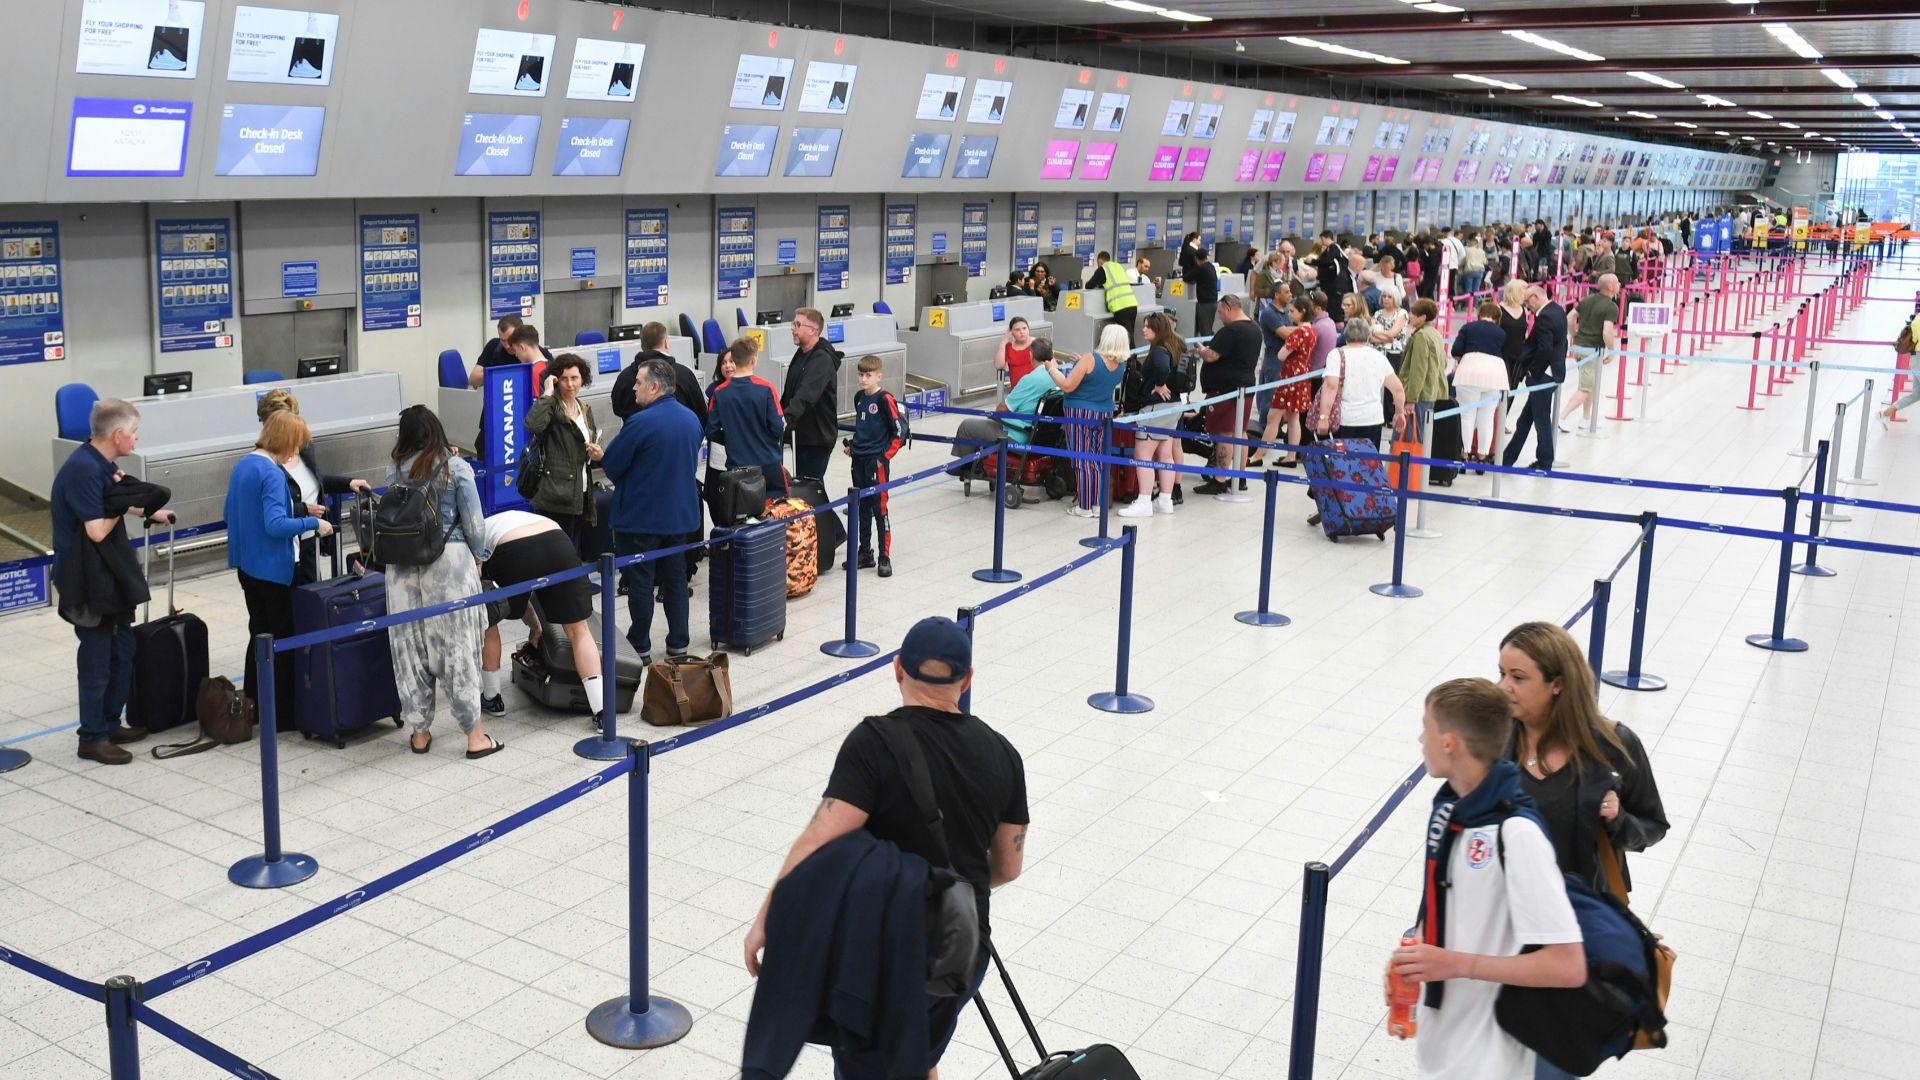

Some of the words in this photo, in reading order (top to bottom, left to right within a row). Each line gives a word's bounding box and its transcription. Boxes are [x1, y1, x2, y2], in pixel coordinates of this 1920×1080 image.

[518, 0, 529, 21] 6
[114, 22, 144, 30] SHOPPING
[612, 10, 624, 32] 7
[149, 106, 187, 114] SunExpress
[240, 127, 279, 139] Check-in
[280, 129, 303, 140] Desk
[475, 133, 506, 144] Check-in
[506, 134, 524, 144] Desk
[571, 136, 599, 146] Check-in
[599, 137, 614, 147] Desk
[255, 142, 286, 154] Closed
[486, 146, 509, 156] Closed
[580, 149, 601, 158] Closed
[1130, 459, 1153, 468] Departure
[173, 975, 190, 986] LONDON
[191, 968, 205, 978] LUTON
